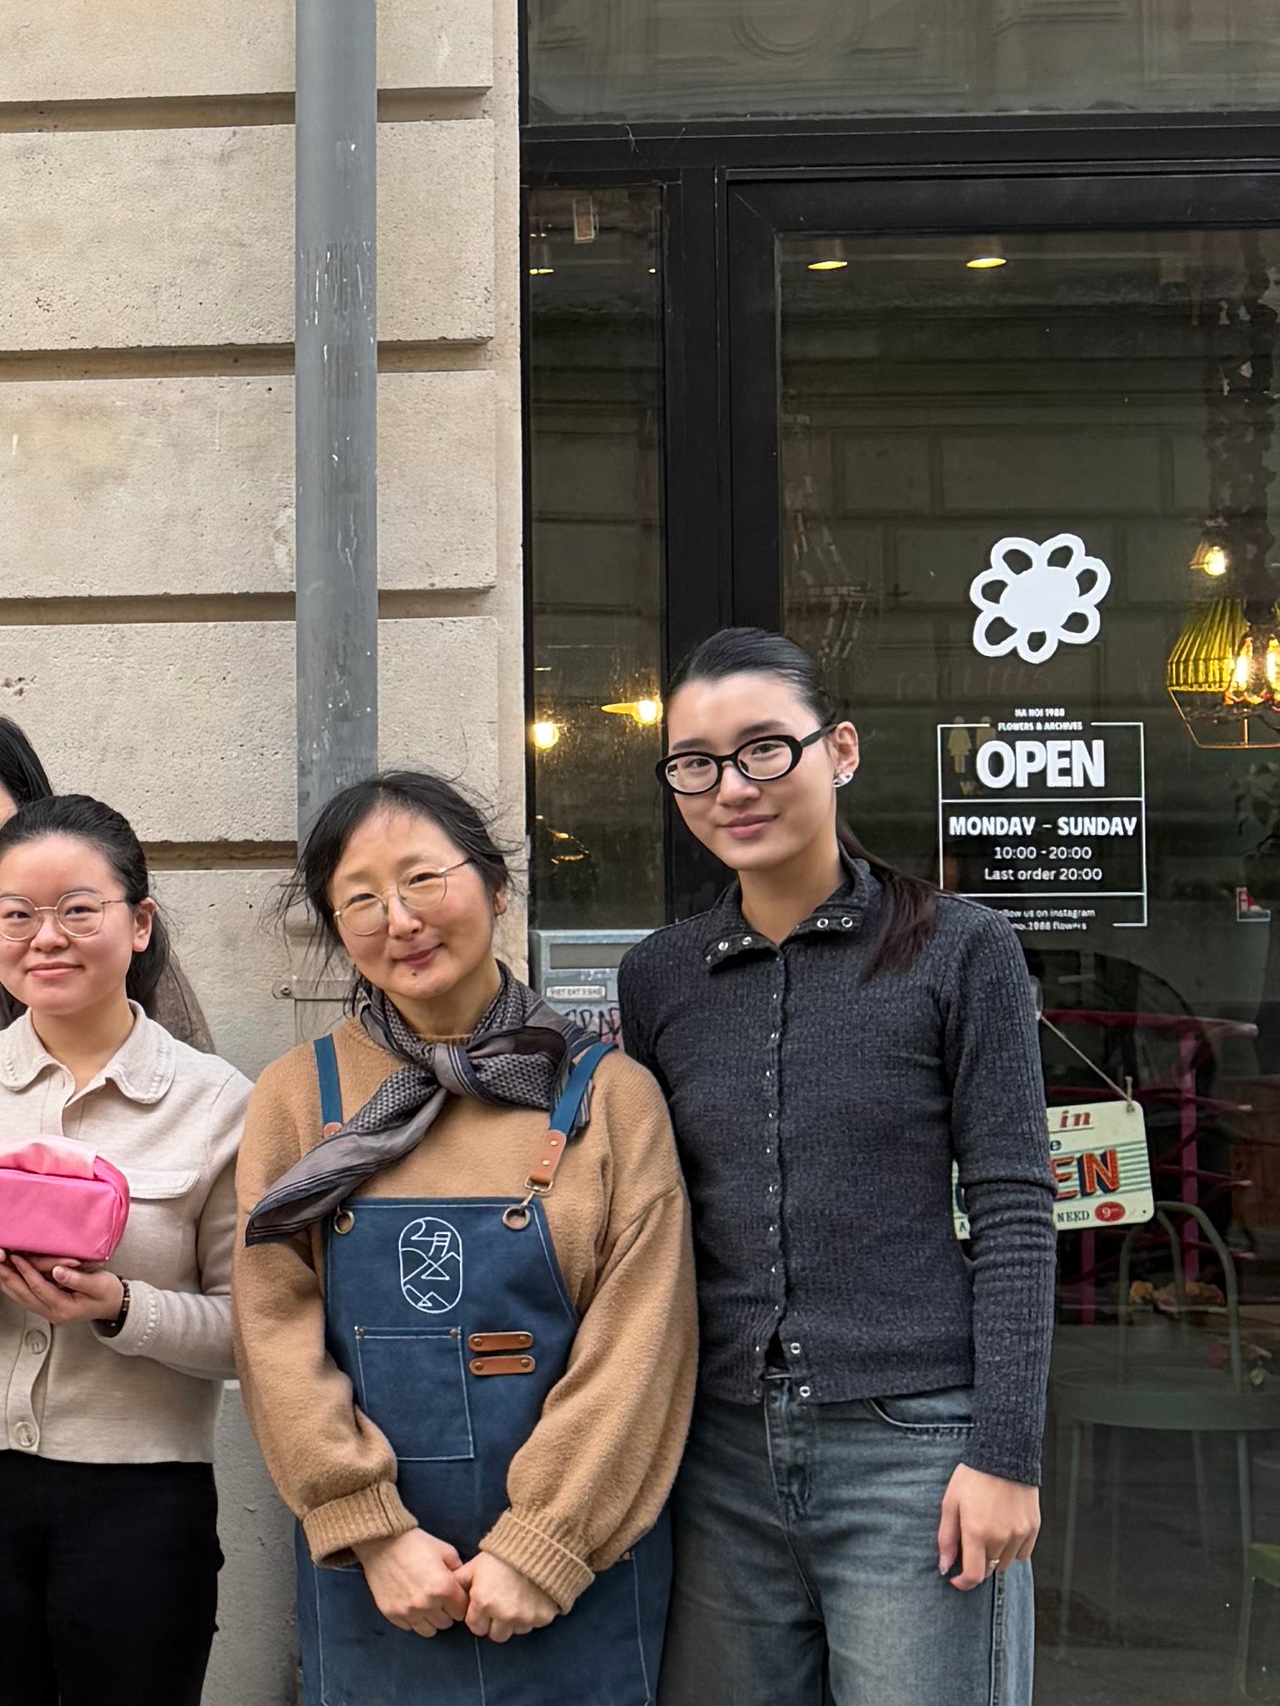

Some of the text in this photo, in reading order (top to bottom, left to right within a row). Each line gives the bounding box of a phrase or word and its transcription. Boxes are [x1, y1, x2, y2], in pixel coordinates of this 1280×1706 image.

[997, 722, 1035, 731] FLOWERS
[1043, 721, 1083, 731] ARCHIVES
[976, 740, 1105, 789] OPEN
[949, 816, 1036, 836] MONDAY
[1057, 816, 1138, 836] SUNDAY
[993, 846, 1037, 860] 10:00
[1049, 846, 1093, 860] 20:00
[984, 868, 1103, 881] Last order 20:00
[1036, 909, 1049, 918] on
[1050, 1148, 1122, 1203] EN
[1056, 1210, 1090, 1223] NEED
